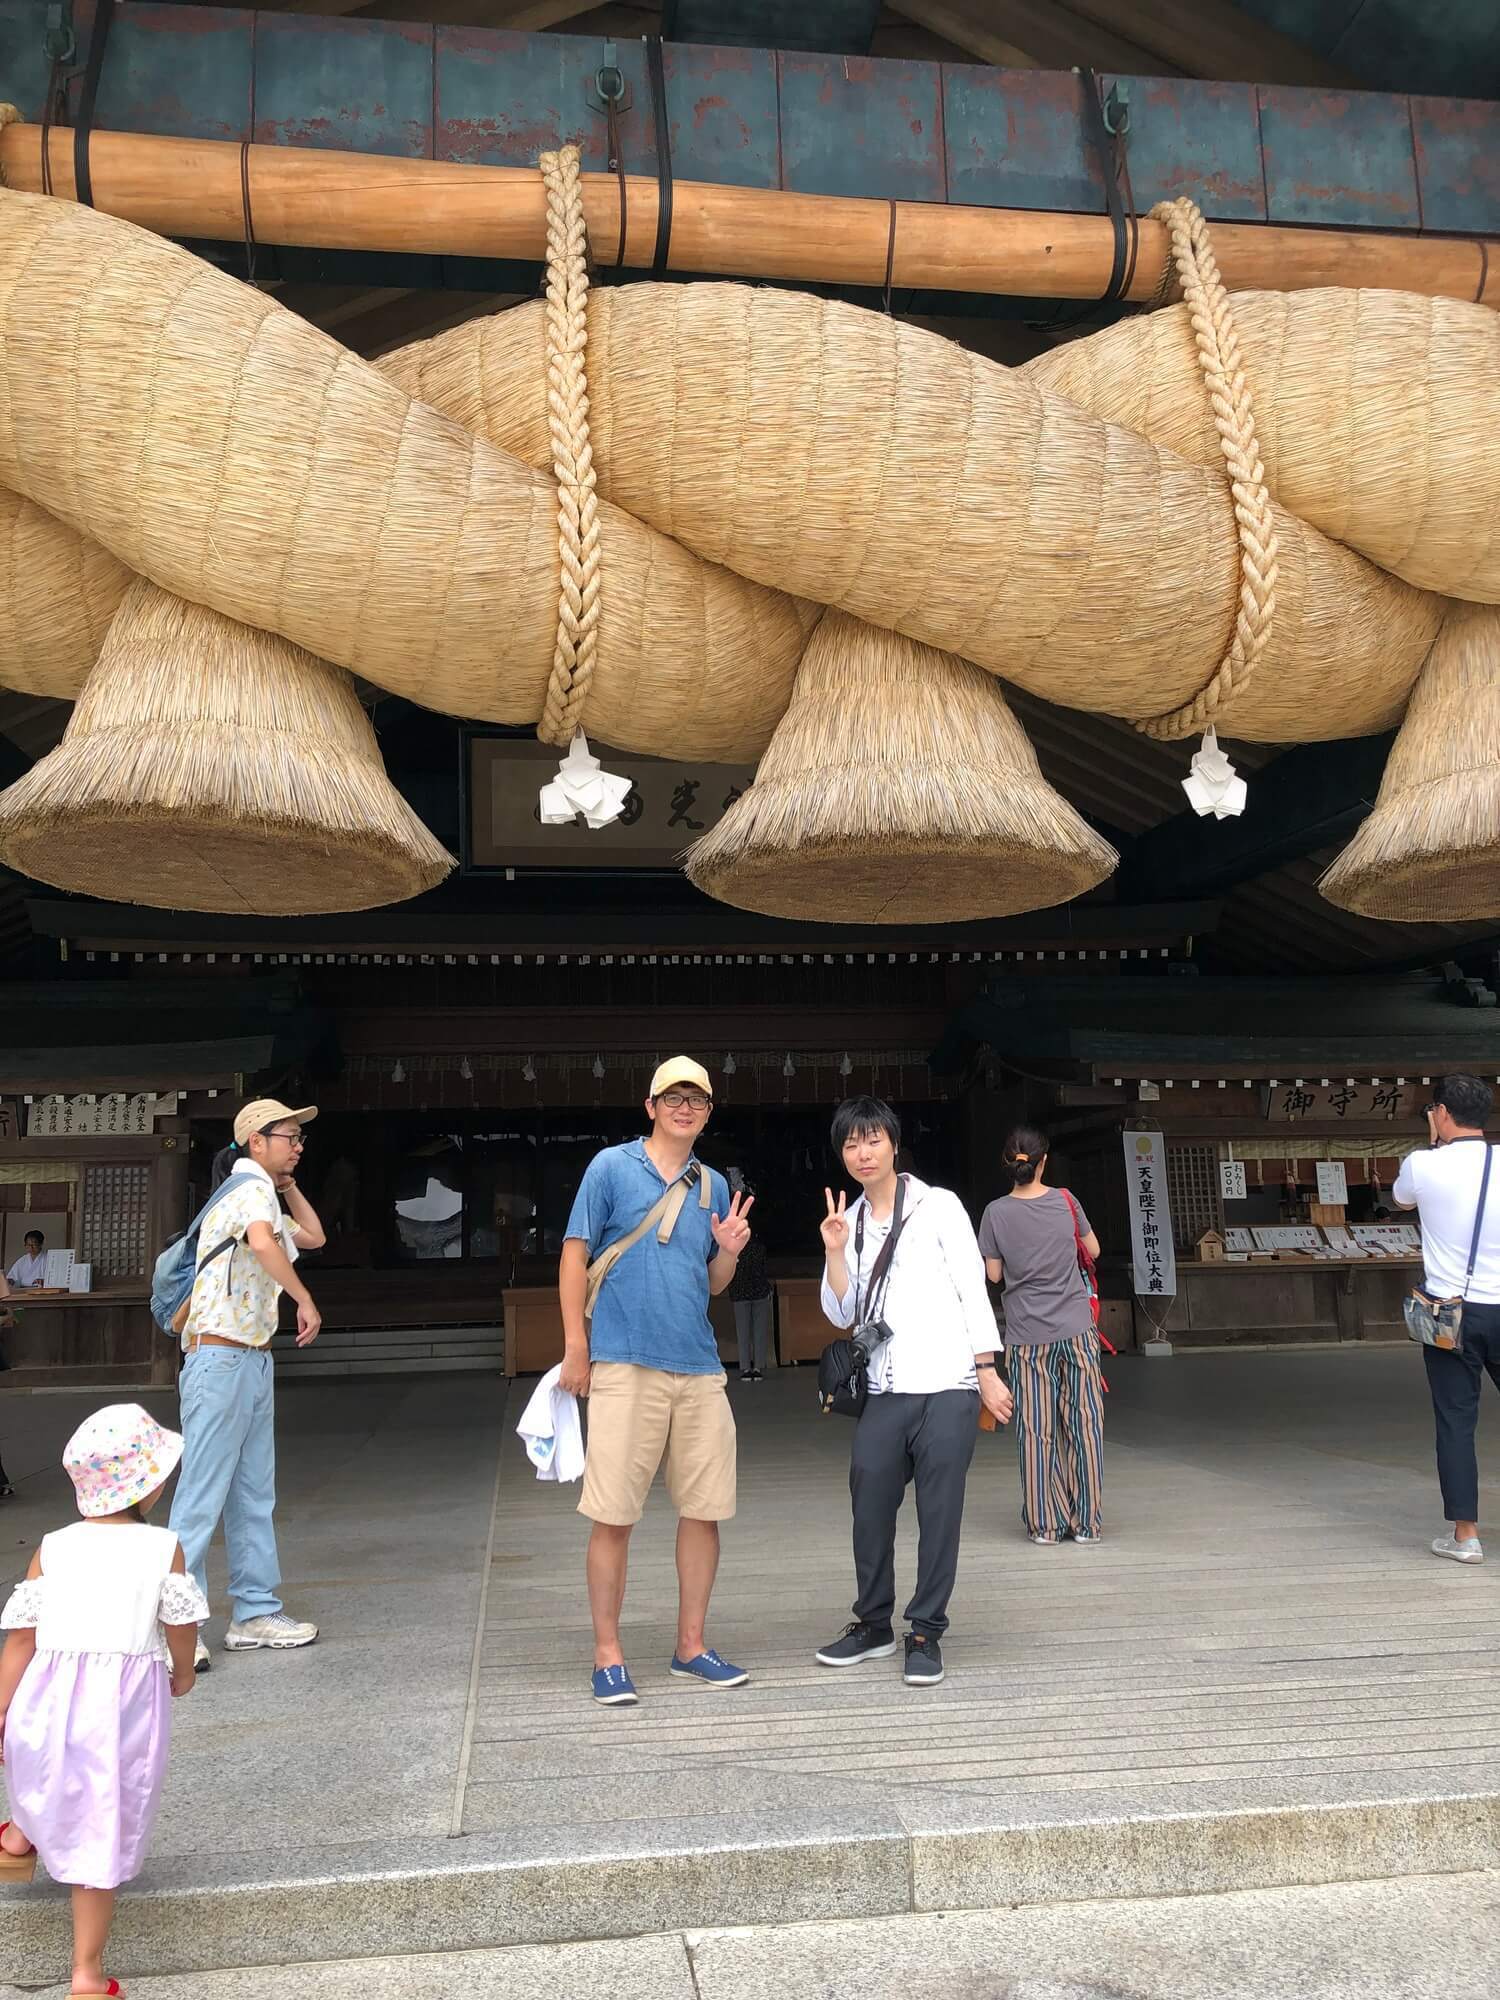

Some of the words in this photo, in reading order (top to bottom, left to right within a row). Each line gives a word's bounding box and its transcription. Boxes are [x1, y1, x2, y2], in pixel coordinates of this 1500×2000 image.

[136, 1095, 146, 1131] 家内安全
[1282, 1086, 1404, 1117] 御守所
[1138, 1167, 1164, 1293] 天皇陛下御即位大典
